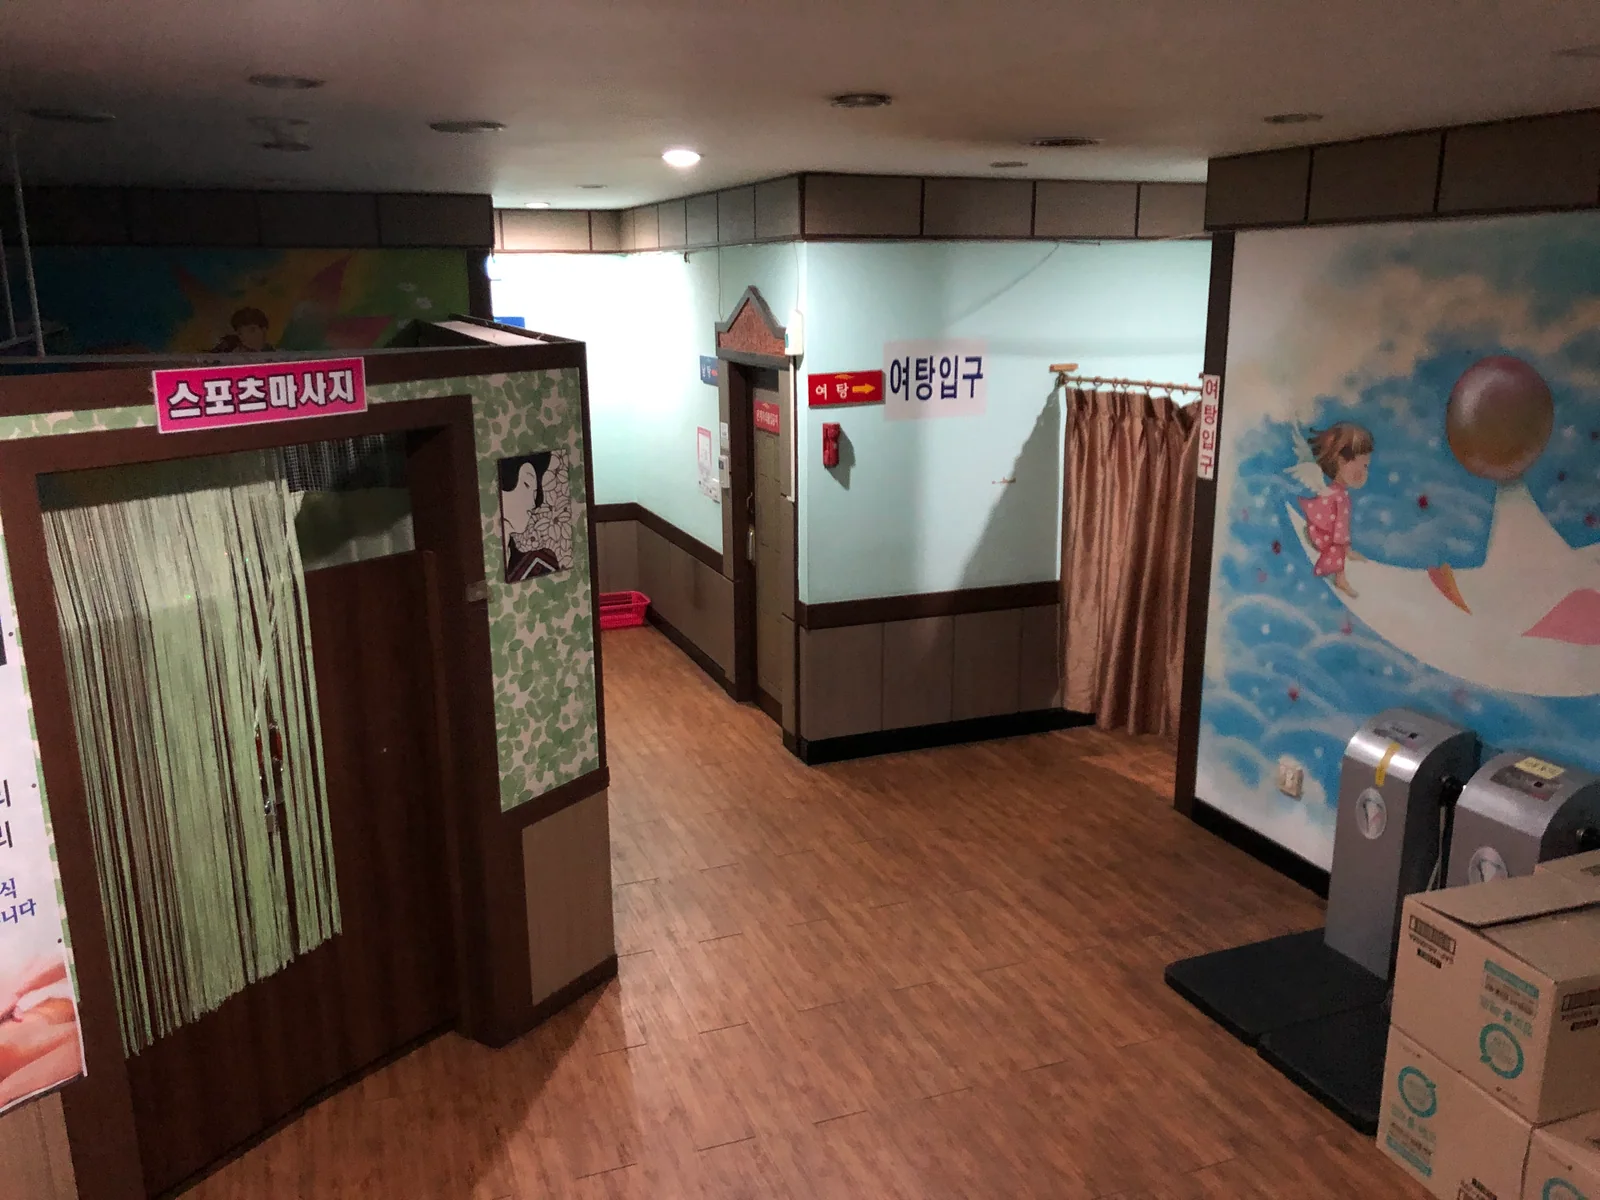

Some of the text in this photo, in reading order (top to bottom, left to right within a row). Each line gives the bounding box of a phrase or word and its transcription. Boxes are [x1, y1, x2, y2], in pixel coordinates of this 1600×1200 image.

[168, 369, 355, 419] 스포츠마사지
[890, 355, 984, 401] 여탕입구
[1200, 379, 1218, 475] 여탕입구
